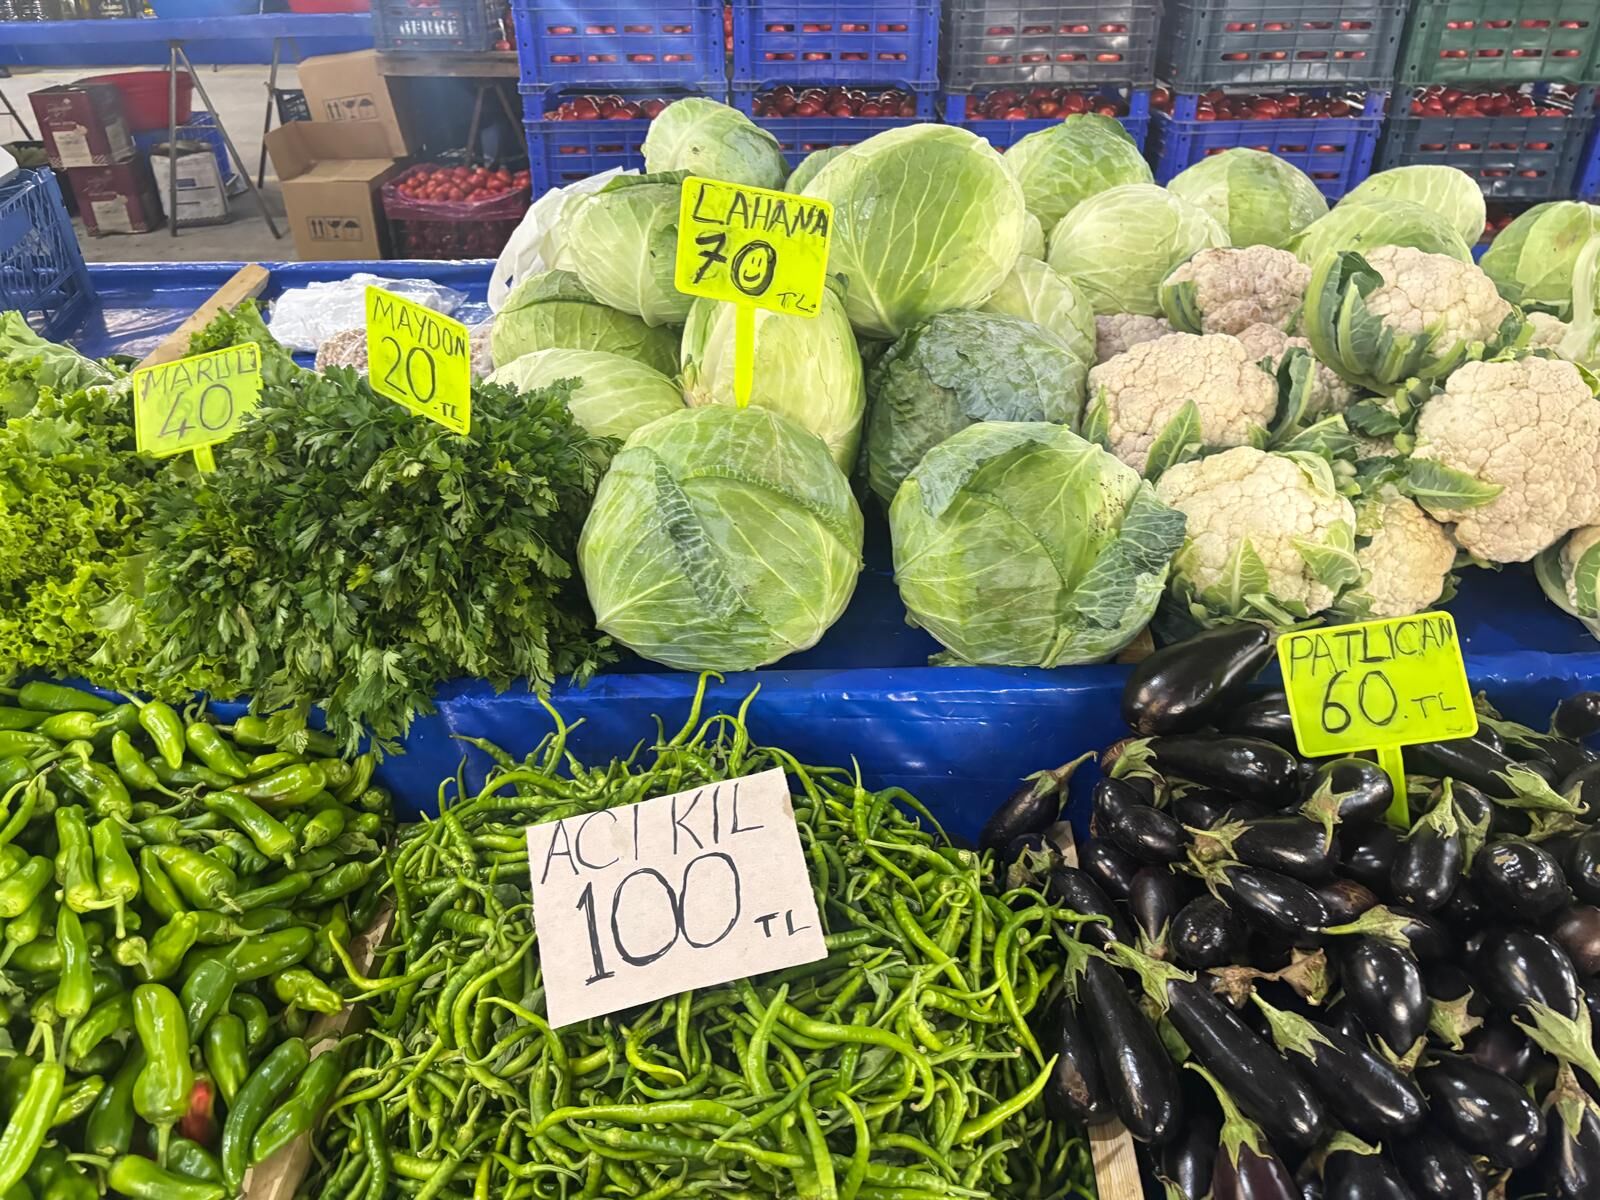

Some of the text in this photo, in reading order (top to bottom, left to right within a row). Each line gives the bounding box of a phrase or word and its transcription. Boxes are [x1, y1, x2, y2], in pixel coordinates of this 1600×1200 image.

[692, 183, 830, 239] LAHANA
[692, 231, 777, 297] 70
[373, 295, 466, 359] MAYDON
[141, 349, 257, 402] MARUL
[381, 335, 436, 404] 20
[157, 383, 234, 441] 40
[1290, 618, 1453, 682] PATLICAN
[1321, 670, 1398, 735] 60
[541, 782, 765, 885] ACI KIL
[576, 851, 812, 986] 100 TL
